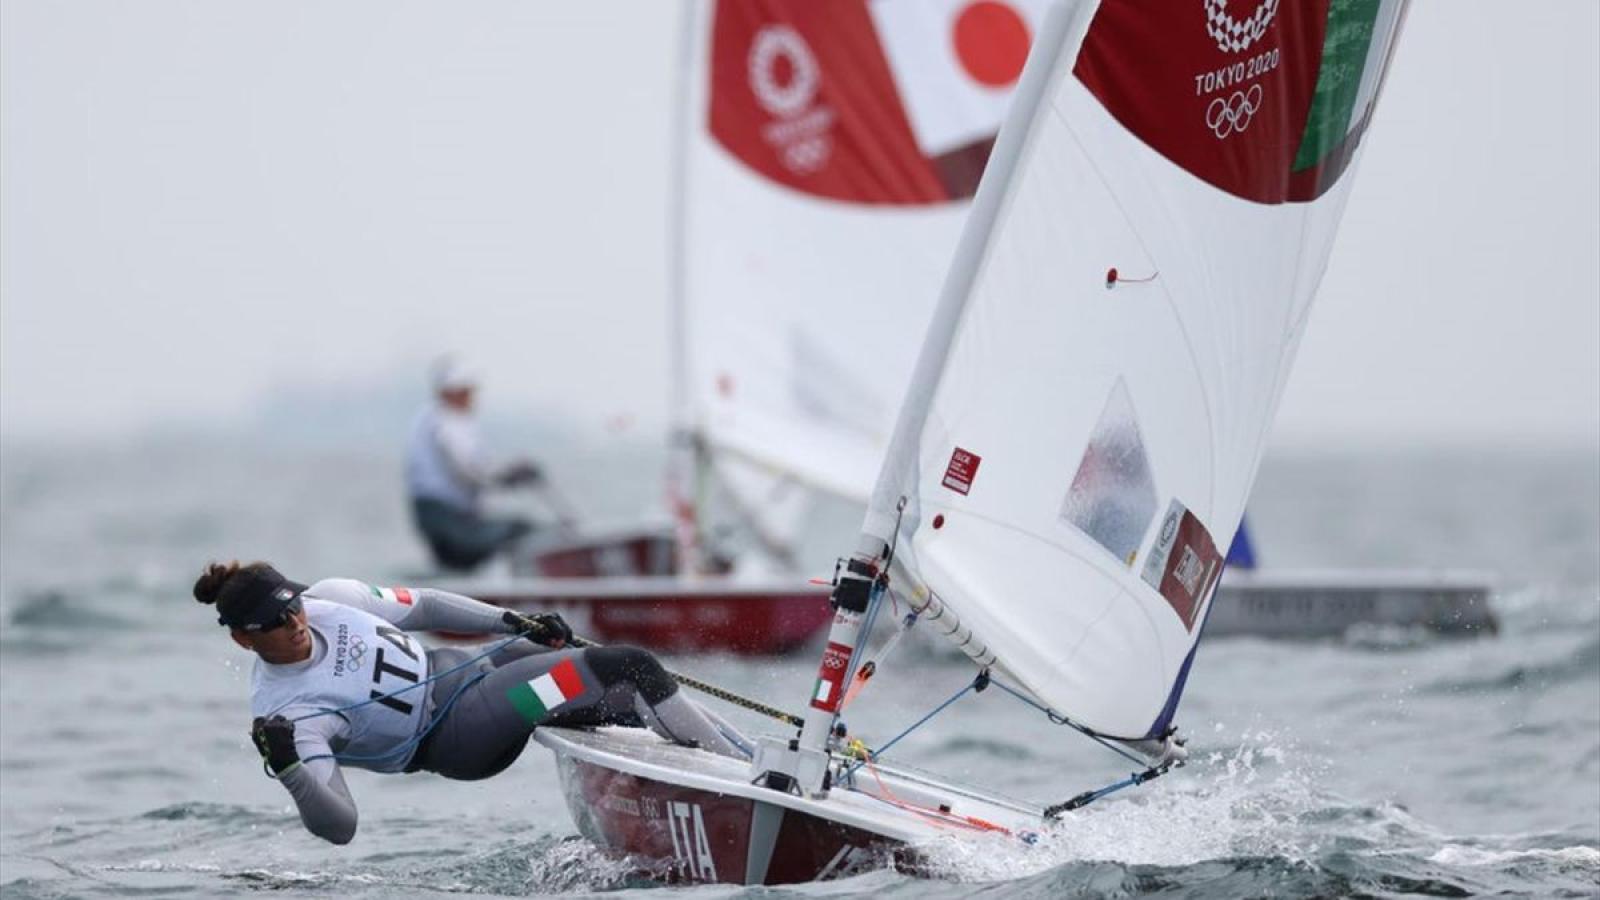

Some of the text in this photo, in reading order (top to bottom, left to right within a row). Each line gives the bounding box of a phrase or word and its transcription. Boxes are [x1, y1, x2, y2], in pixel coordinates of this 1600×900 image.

[1195, 49, 1280, 96] TOKYO 2020
[334, 647, 346, 677] TOKYO
[370, 626, 419, 715] ITA
[667, 801, 717, 881] ITA
